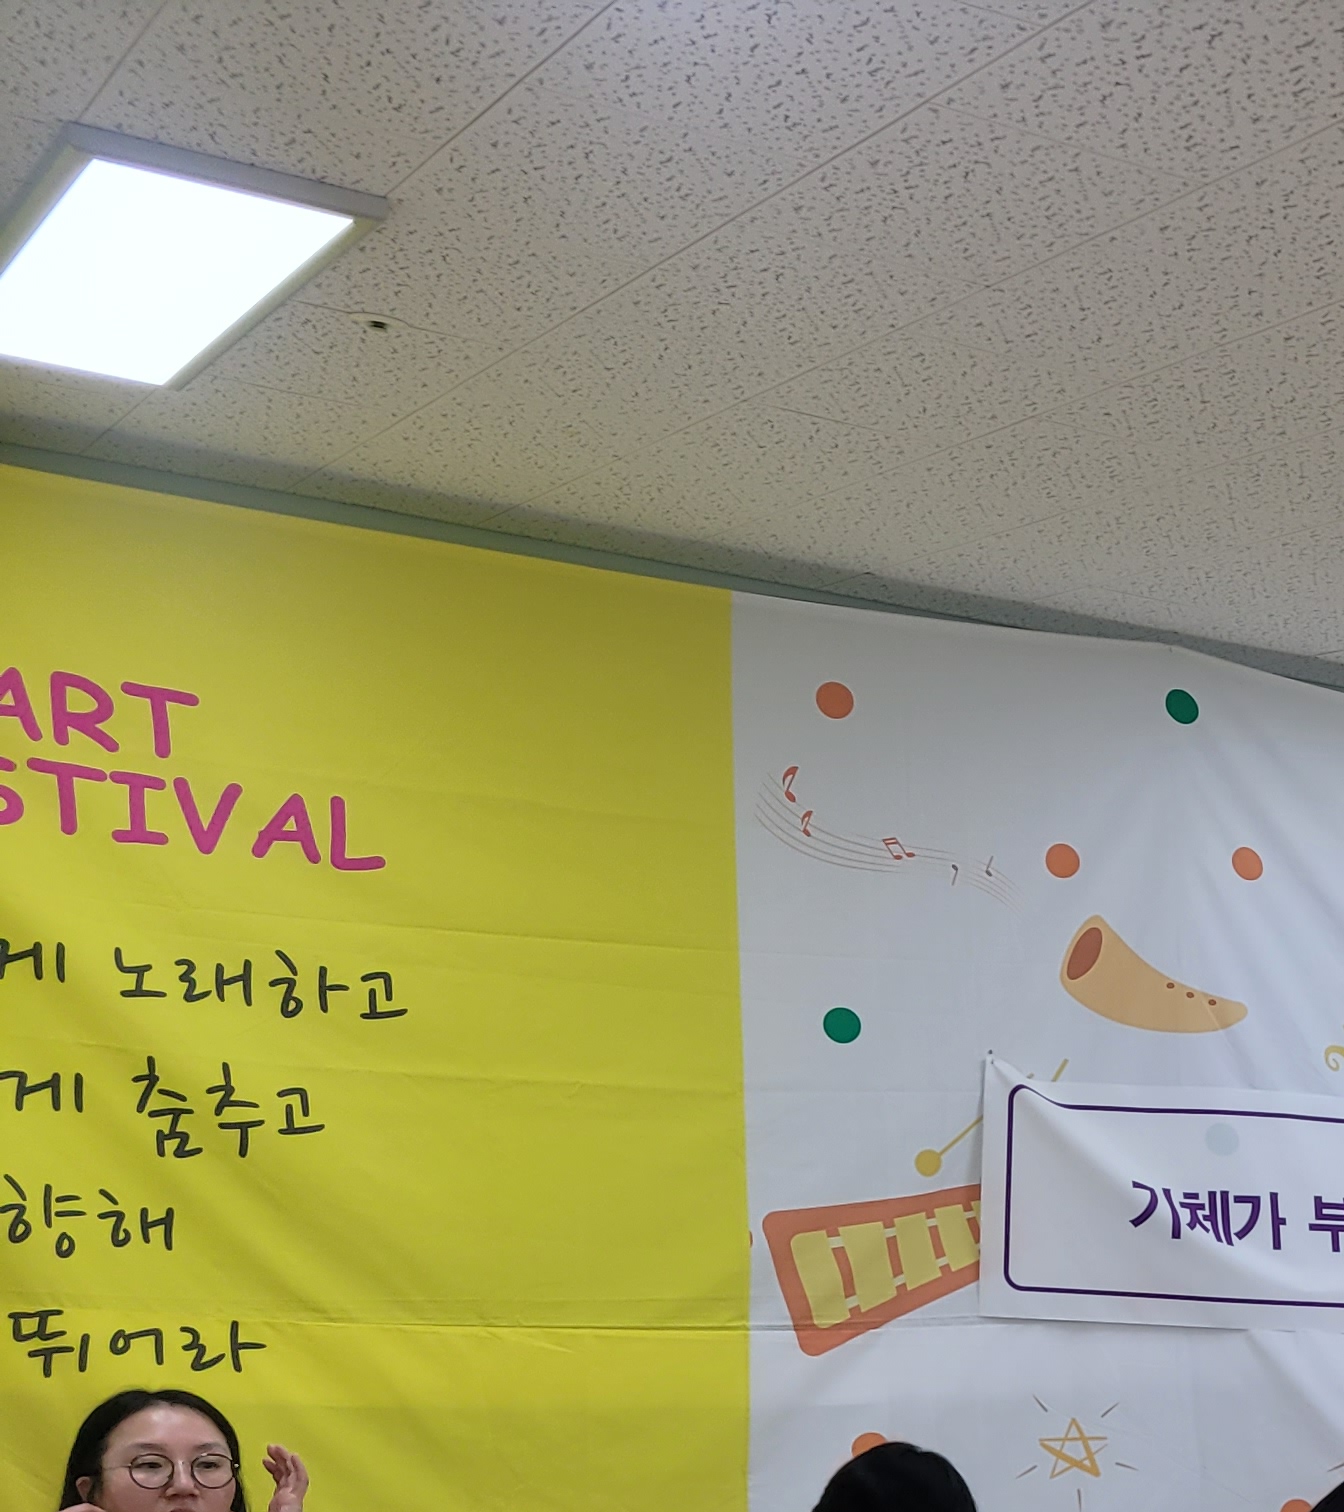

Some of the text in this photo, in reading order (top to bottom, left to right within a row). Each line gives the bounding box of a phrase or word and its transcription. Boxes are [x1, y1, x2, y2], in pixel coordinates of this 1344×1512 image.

[113, 947, 409, 1021] 노래하고
[131, 1055, 326, 1160] 춤추고
[0, 1172, 176, 1260] 향해
[1127, 1179, 1288, 1252] 기체가
[6, 1307, 269, 1381] 뛰어라
